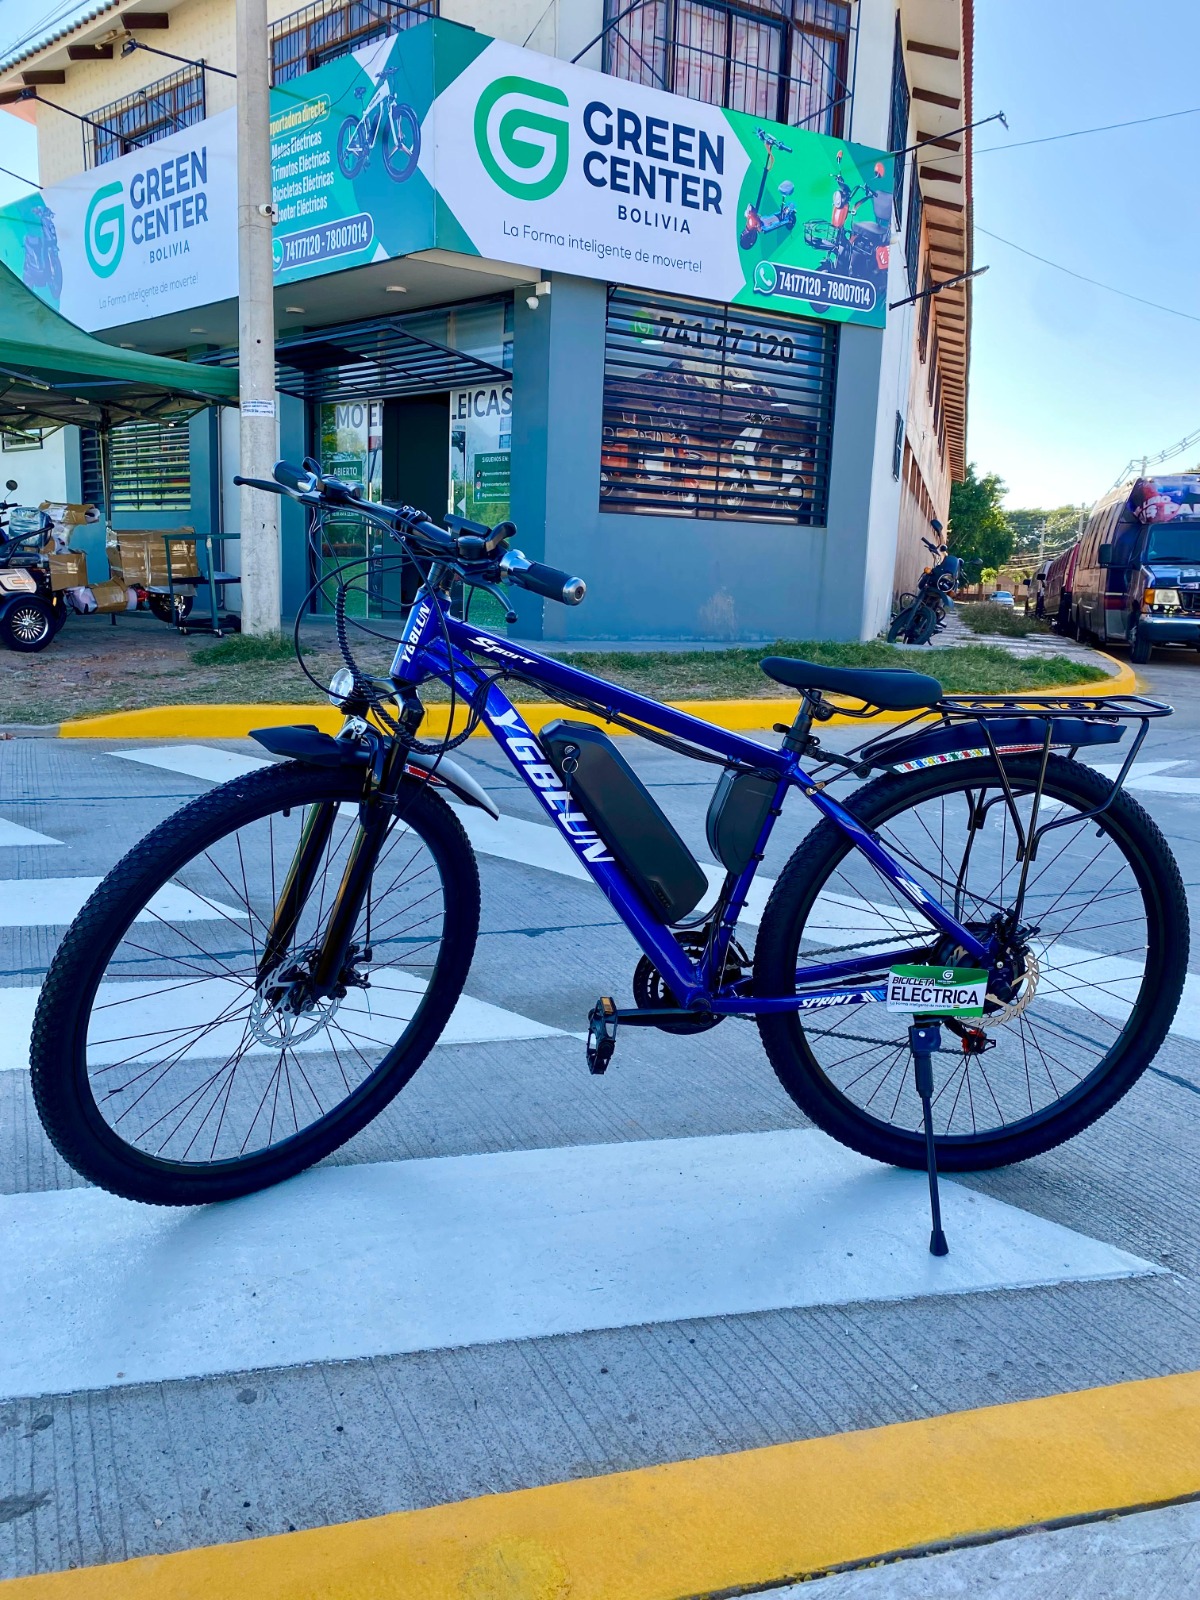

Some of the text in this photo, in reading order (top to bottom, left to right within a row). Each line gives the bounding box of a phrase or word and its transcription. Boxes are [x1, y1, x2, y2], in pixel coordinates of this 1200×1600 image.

[302, 101, 327, 124] directa:
[272, 143, 291, 160] Motos
[583, 101, 724, 175] GREEN
[130, 146, 207, 209] GREEN
[272, 150, 330, 182] Trimotos Eléctricas
[272, 171, 334, 203] Bicicletas Eléctricas
[583, 151, 722, 214] CENTER
[132, 192, 208, 245] CENTER
[277, 204, 296, 223] cooter
[618, 205, 691, 234] BOLIVIA
[150, 240, 190, 263] BOLIVIA
[285, 234, 320, 262] 74177120
[325, 221, 368, 252] 78007014
[503, 220, 702, 273] La Forma inteligente de moverte!
[98, 273, 199, 309] La Forma inteligente de moverte!
[779, 271, 821, 296] 74177120
[827, 280, 870, 305] 78007014
[333, 466, 358, 477] ABIERTO
[401, 603, 431, 663] YGBLUN
[491, 708, 616, 863] YGBLUN
[890, 986, 979, 1006] ELECTRICA
[892, 976, 935, 987] BICICLETA
[799, 994, 857, 1008] SPRINT
